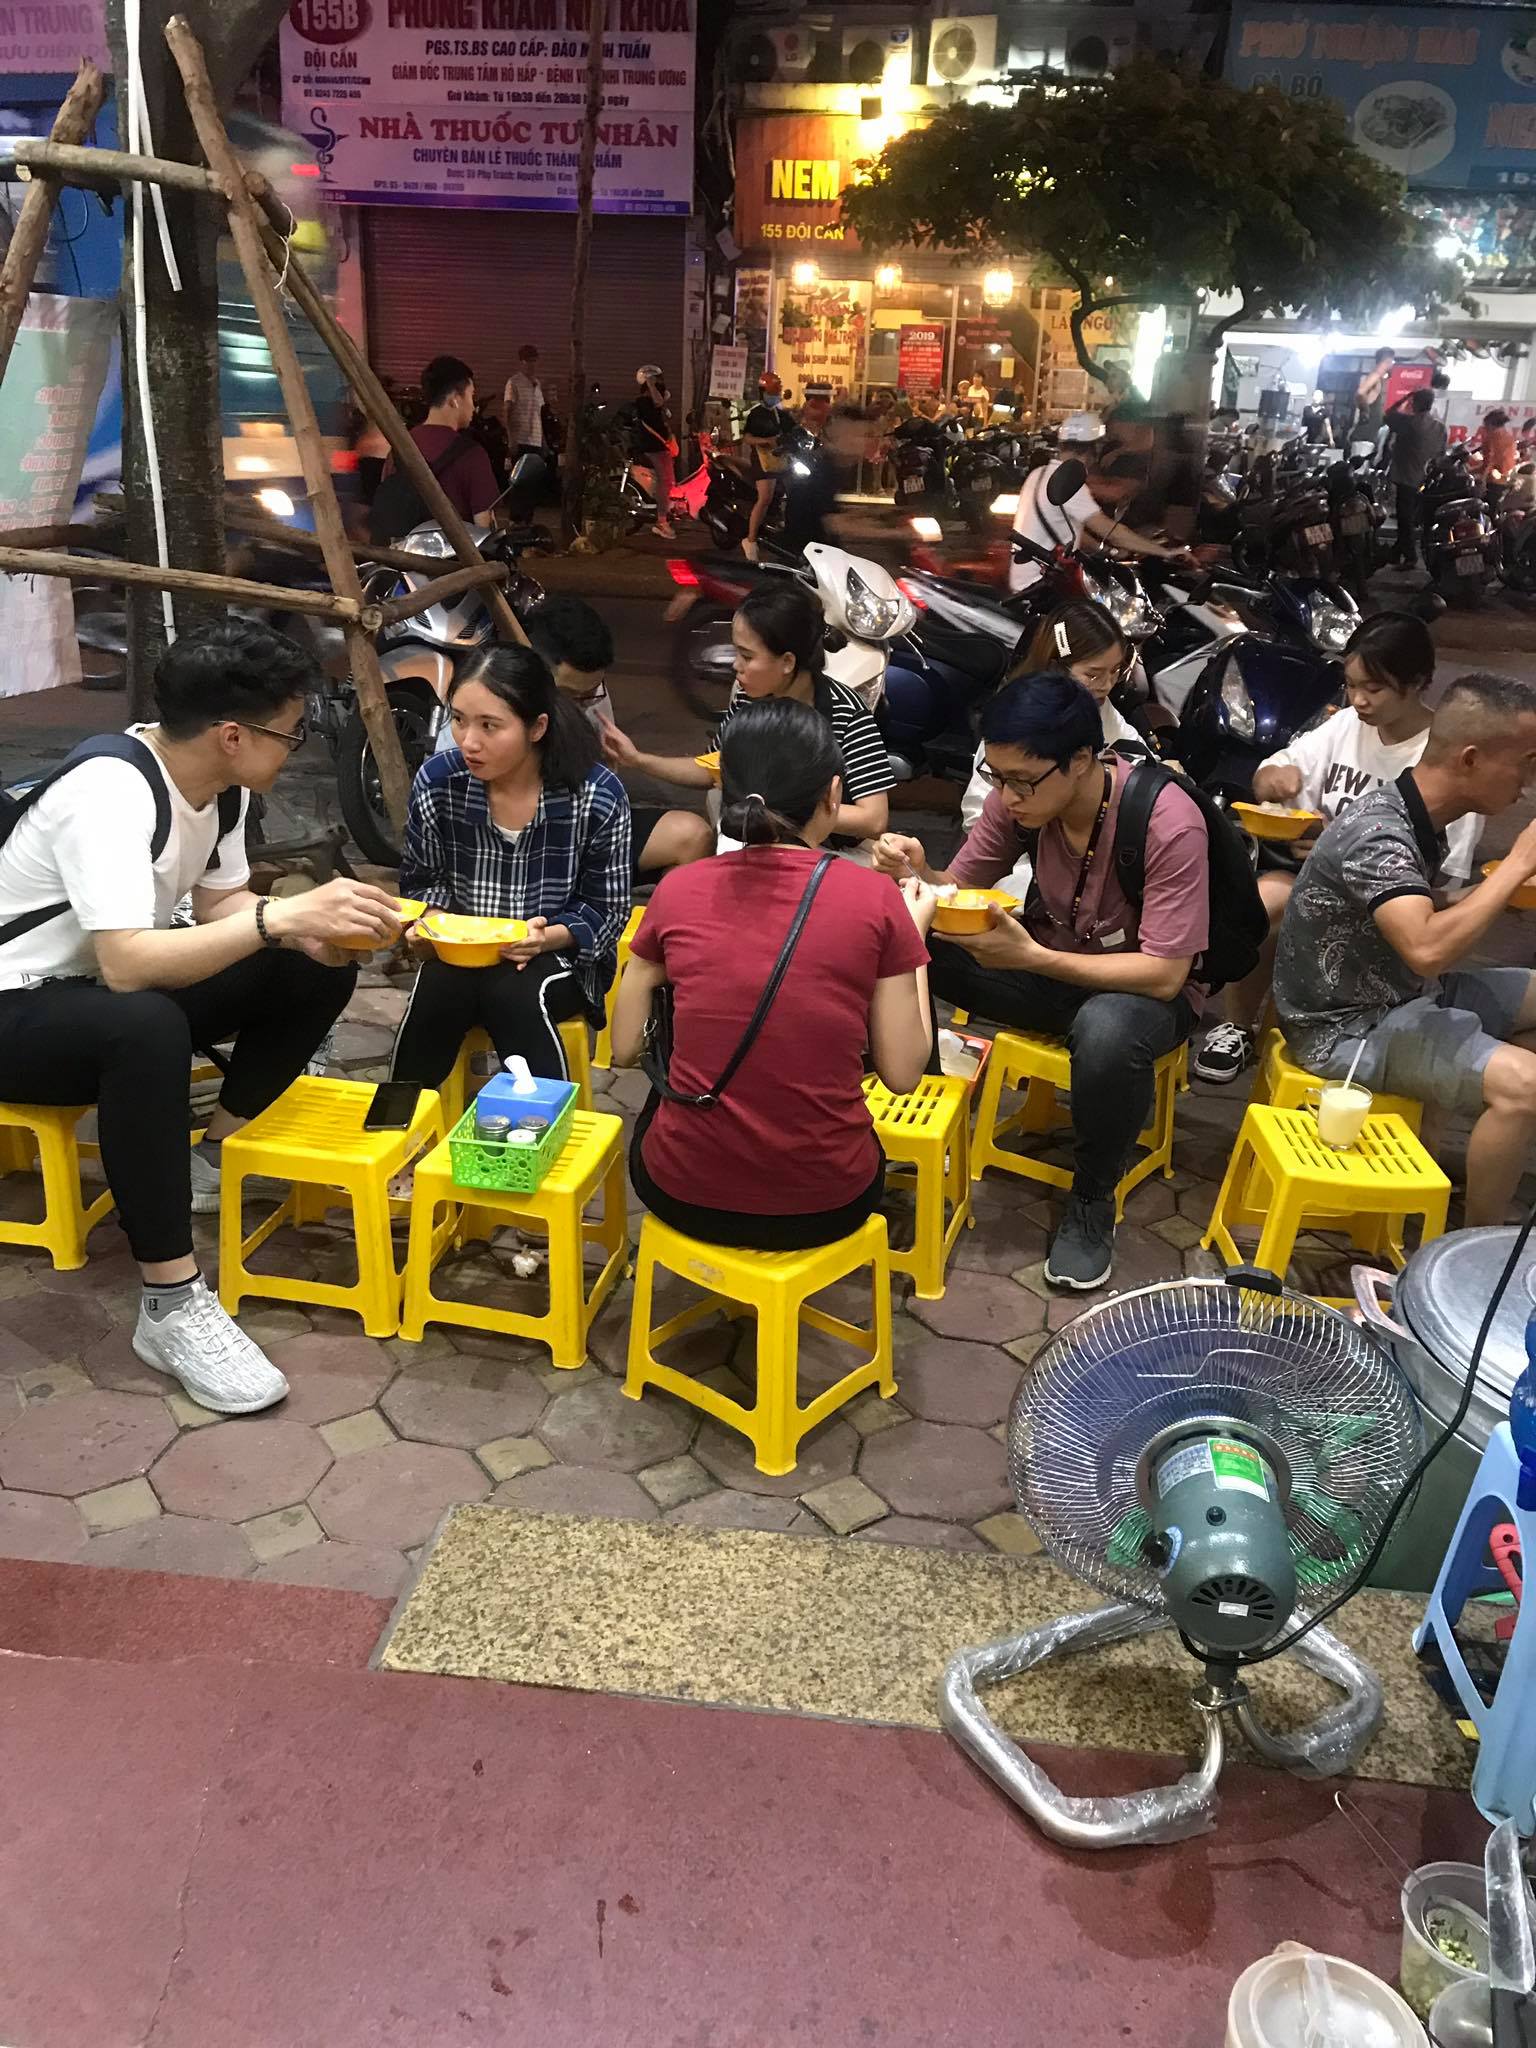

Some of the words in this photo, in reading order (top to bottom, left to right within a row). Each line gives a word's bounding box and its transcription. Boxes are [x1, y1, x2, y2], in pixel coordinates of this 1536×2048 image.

[20, 4, 94, 34] TRUNG
[297, 0, 359, 30] 155B
[304, 48, 326, 71] ĐỘI
[330, 46, 357, 68] CẤN
[425, 39, 488, 56] PGS.TS.BS
[491, 41, 516, 56] CAO
[443, 65, 475, 81] TRUNG
[359, 112, 423, 140] NHÀ
[430, 111, 531, 143] THUỐC
[595, 117, 679, 147] NHÂN
[413, 146, 458, 163] CHUYÊN
[505, 147, 542, 166] THUỐC
[771, 159, 840, 200] NEM
[1496, 171, 1536, 185] 15
[761, 223, 782, 238] 155
[786, 221, 811, 242] ĐỘI
[910, 331, 935, 341] 2019
[1325, 762, 1372, 797] NEW
